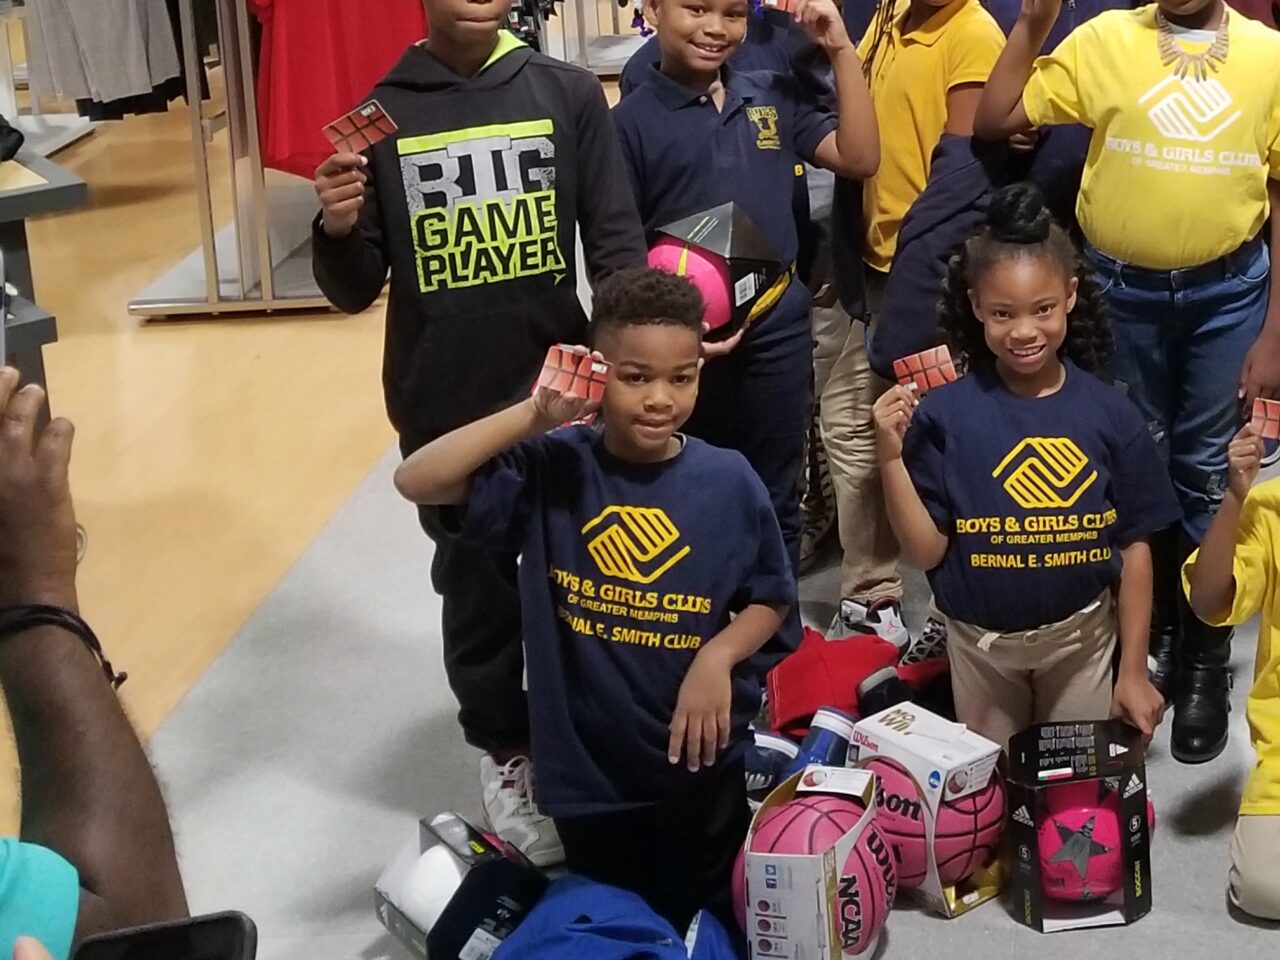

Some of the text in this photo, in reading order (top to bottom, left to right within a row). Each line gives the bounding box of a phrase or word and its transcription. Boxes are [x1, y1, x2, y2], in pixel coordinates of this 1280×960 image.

[1105, 137, 1141, 154] BOYS
[1145, 142, 1158, 158] &
[1162, 144, 1214, 164] GIRLS
[400, 136, 556, 216] BIG
[415, 194, 557, 251] GAME
[421, 239, 562, 289] PLAYER
[956, 516, 1001, 535] BOYS
[1004, 515, 1021, 532] &
[1024, 513, 1079, 533] GIRLS
[990, 530, 1098, 544] OF GREATER MEMPHIS
[971, 547, 1112, 568] BERNAL E. SMITH CLU
[567, 593, 679, 623] OF GREATER MEMPHIS
[581, 579, 595, 598] &
[600, 584, 658, 608] GIRLS
[611, 626, 661, 647] SMITH
[663, 633, 702, 650] CLUB
[837, 874, 862, 950] NCAA
